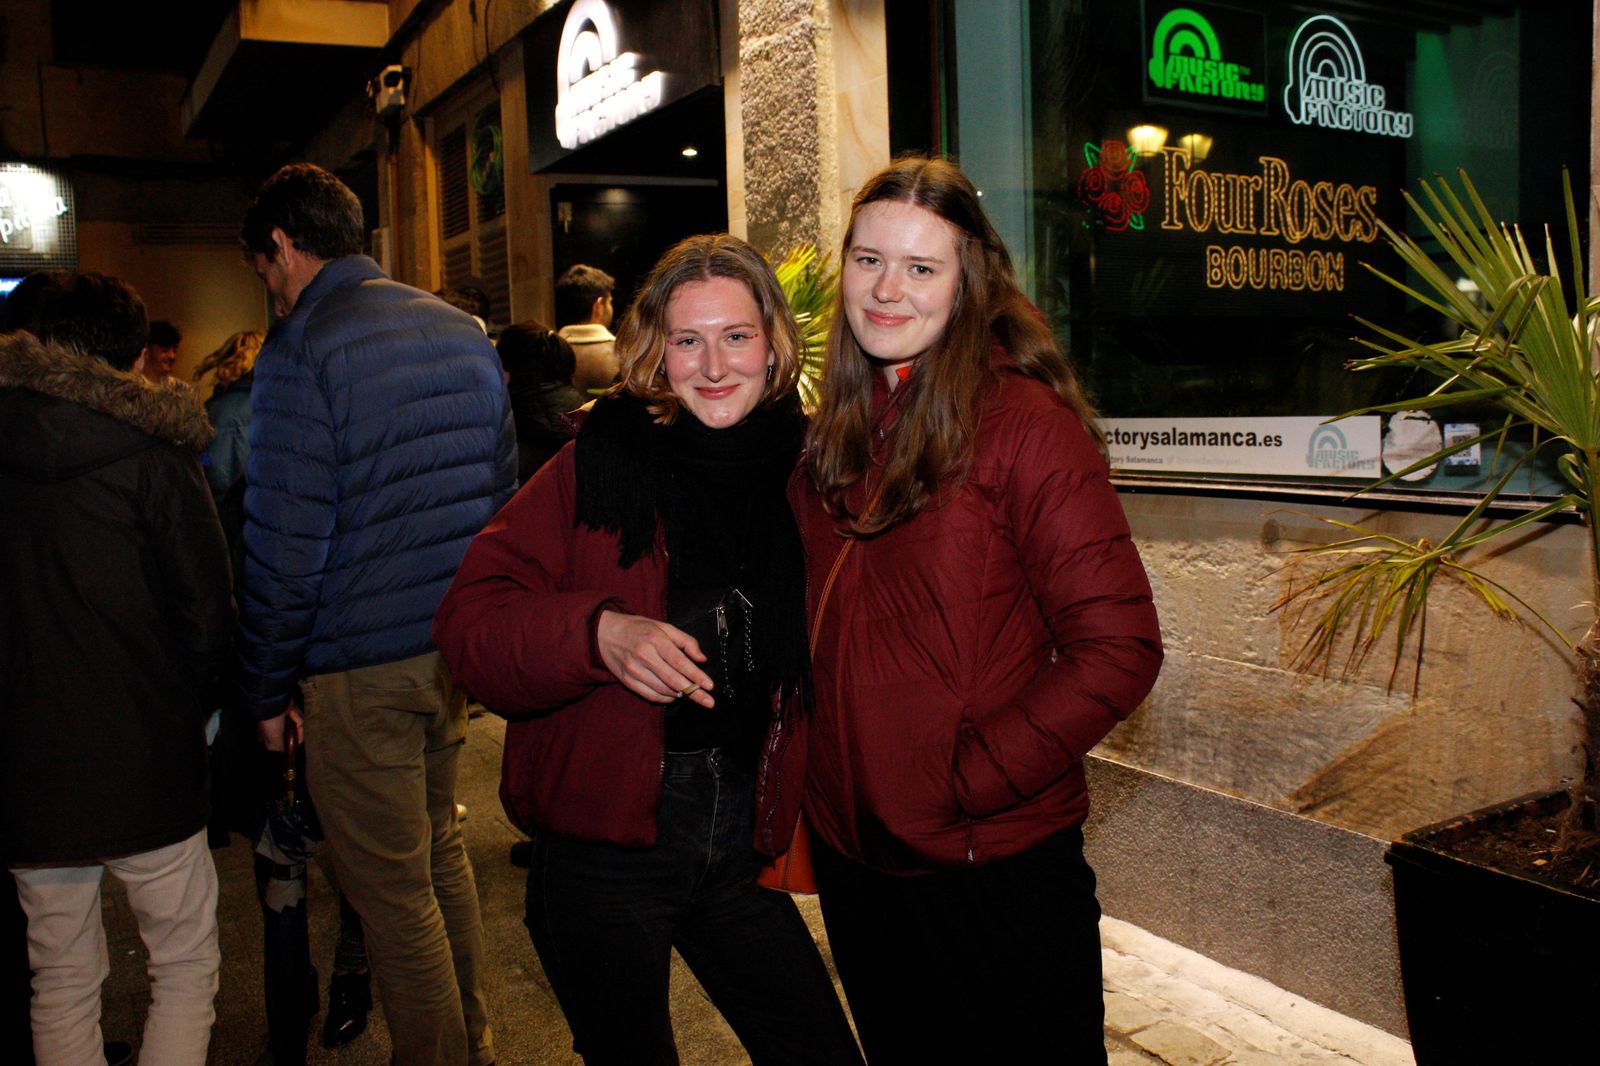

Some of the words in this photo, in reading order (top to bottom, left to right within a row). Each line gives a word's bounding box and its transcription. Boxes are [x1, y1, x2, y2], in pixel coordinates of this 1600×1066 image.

[1165, 54, 1240, 82] MUSIC
[1302, 75, 1386, 111] MUSIC
[1207, 245, 1345, 292] BOURBON
[1104, 427, 1283, 450] ctorysalamanca.es
